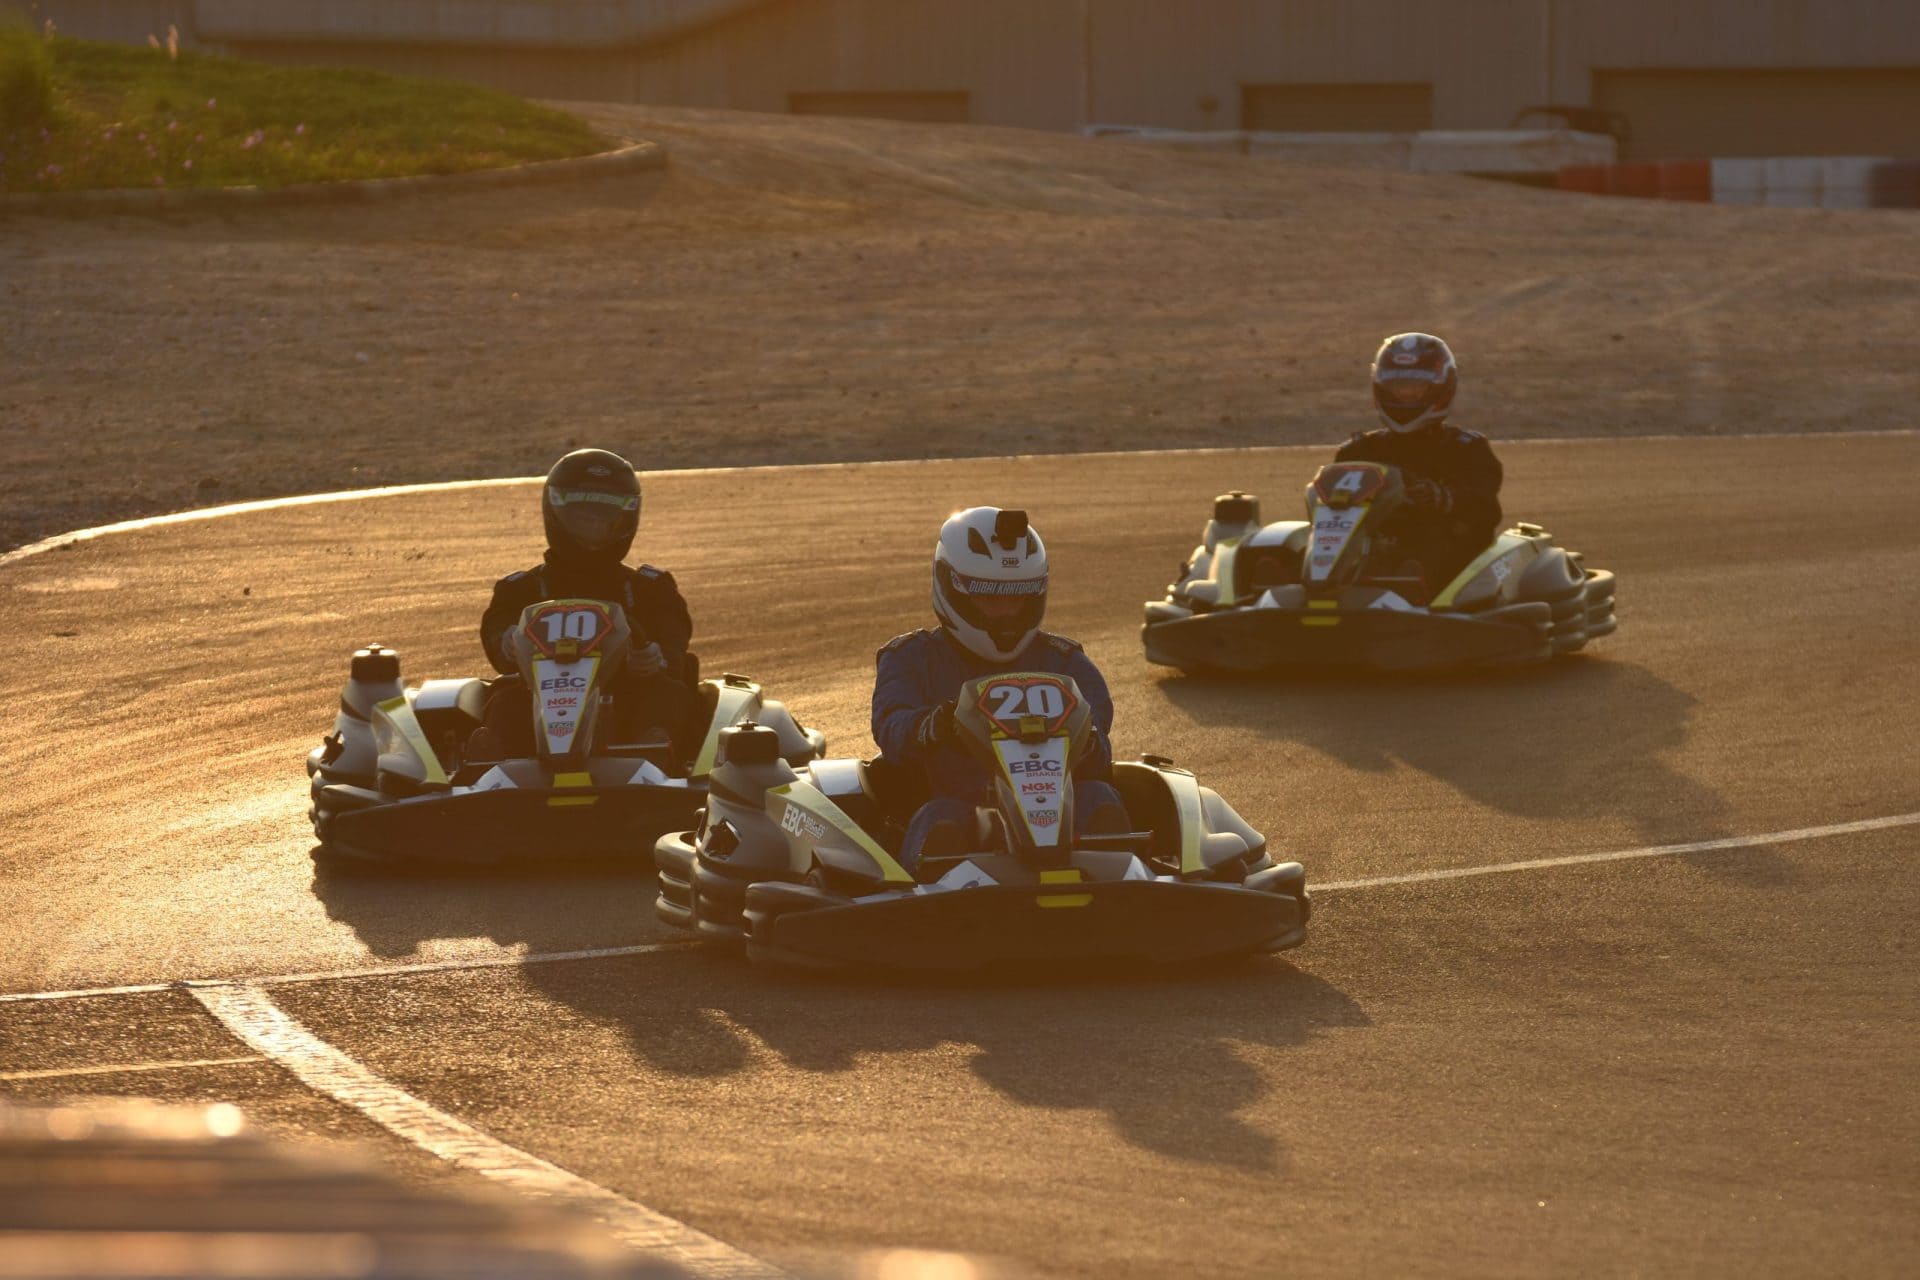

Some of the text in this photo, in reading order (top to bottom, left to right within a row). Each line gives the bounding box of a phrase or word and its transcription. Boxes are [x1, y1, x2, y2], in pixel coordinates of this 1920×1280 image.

[1334, 470, 1365, 492] 4
[1316, 521, 1353, 529] EBC
[1002, 559, 1020, 567] OMP
[969, 580, 997, 593] DUBAI
[540, 611, 597, 642] 10
[541, 677, 586, 690] EBC
[547, 697, 577, 706] NGK
[989, 685, 1064, 720] 20
[1009, 760, 1061, 774] EBC
[1022, 782, 1056, 792] NGK
[781, 802, 807, 837] EBC
